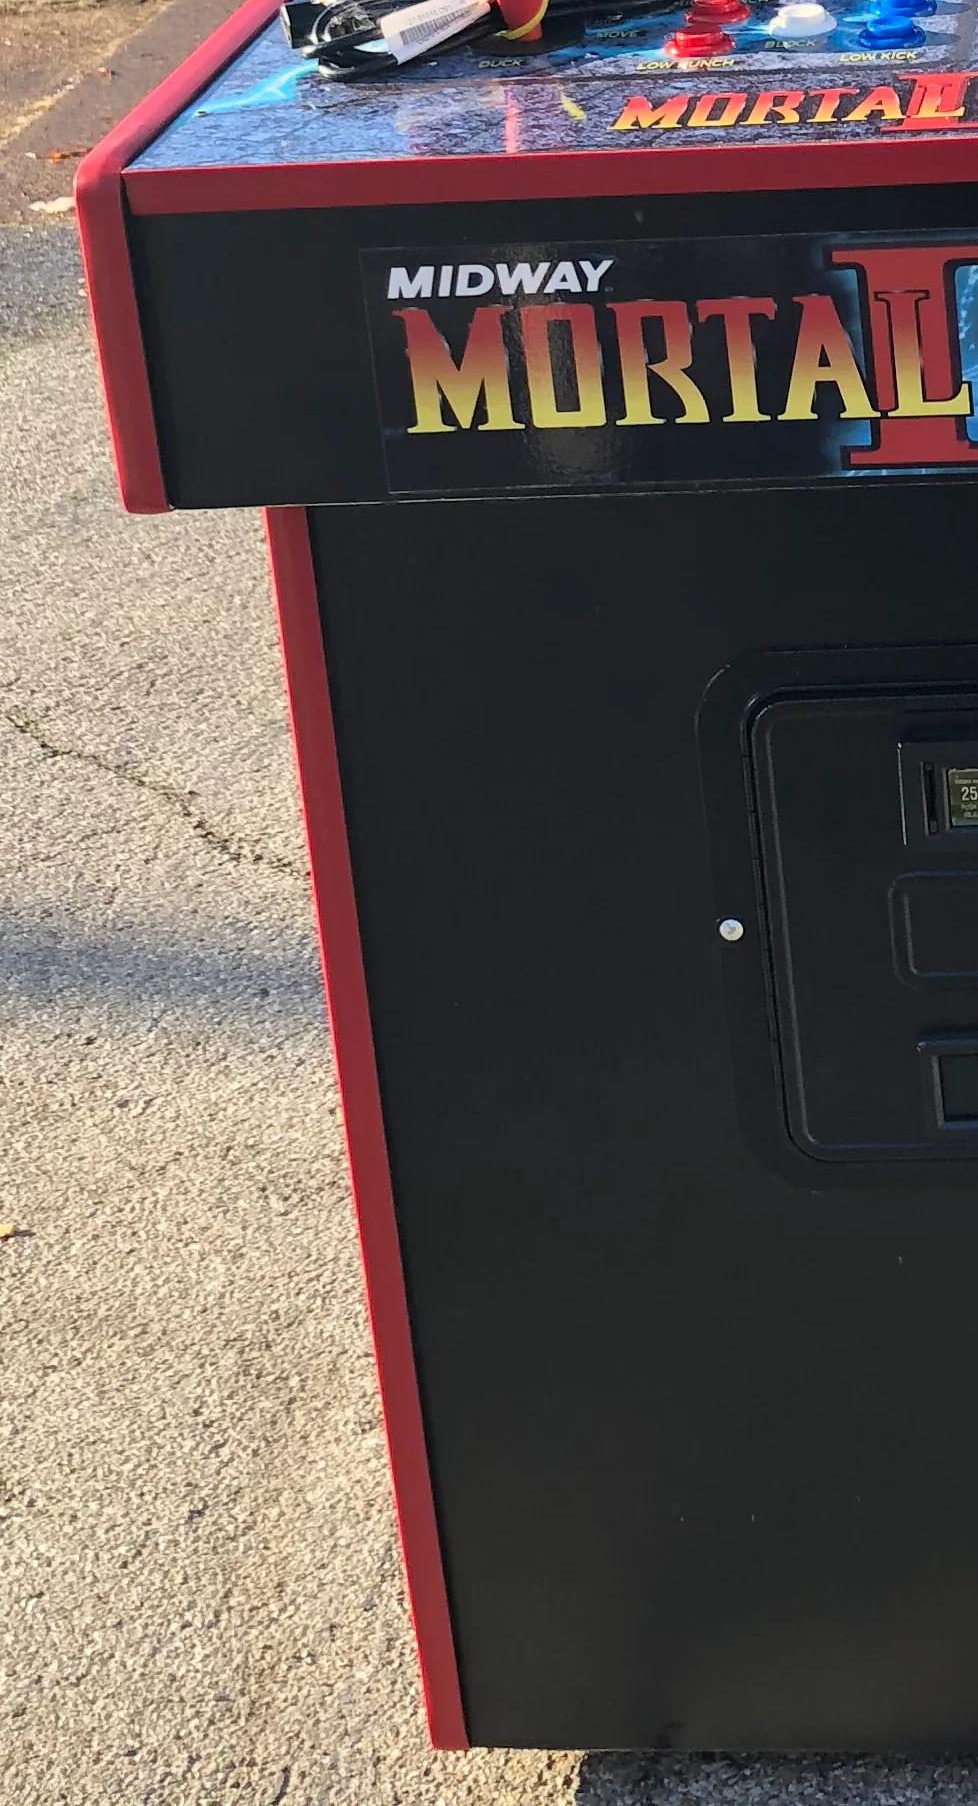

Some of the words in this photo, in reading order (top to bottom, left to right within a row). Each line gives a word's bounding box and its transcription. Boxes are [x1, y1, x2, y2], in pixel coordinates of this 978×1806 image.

[764, 39, 817, 49] BLOCK
[838, 53, 876, 63] LOW
[880, 51, 918, 61] KICK
[478, 59, 524, 68] DUCK
[635, 61, 673, 71] LOW
[606, 83, 966, 131] MORTAL
[387, 259, 614, 300] MIDWAY
[391, 290, 972, 434] MORTAL
